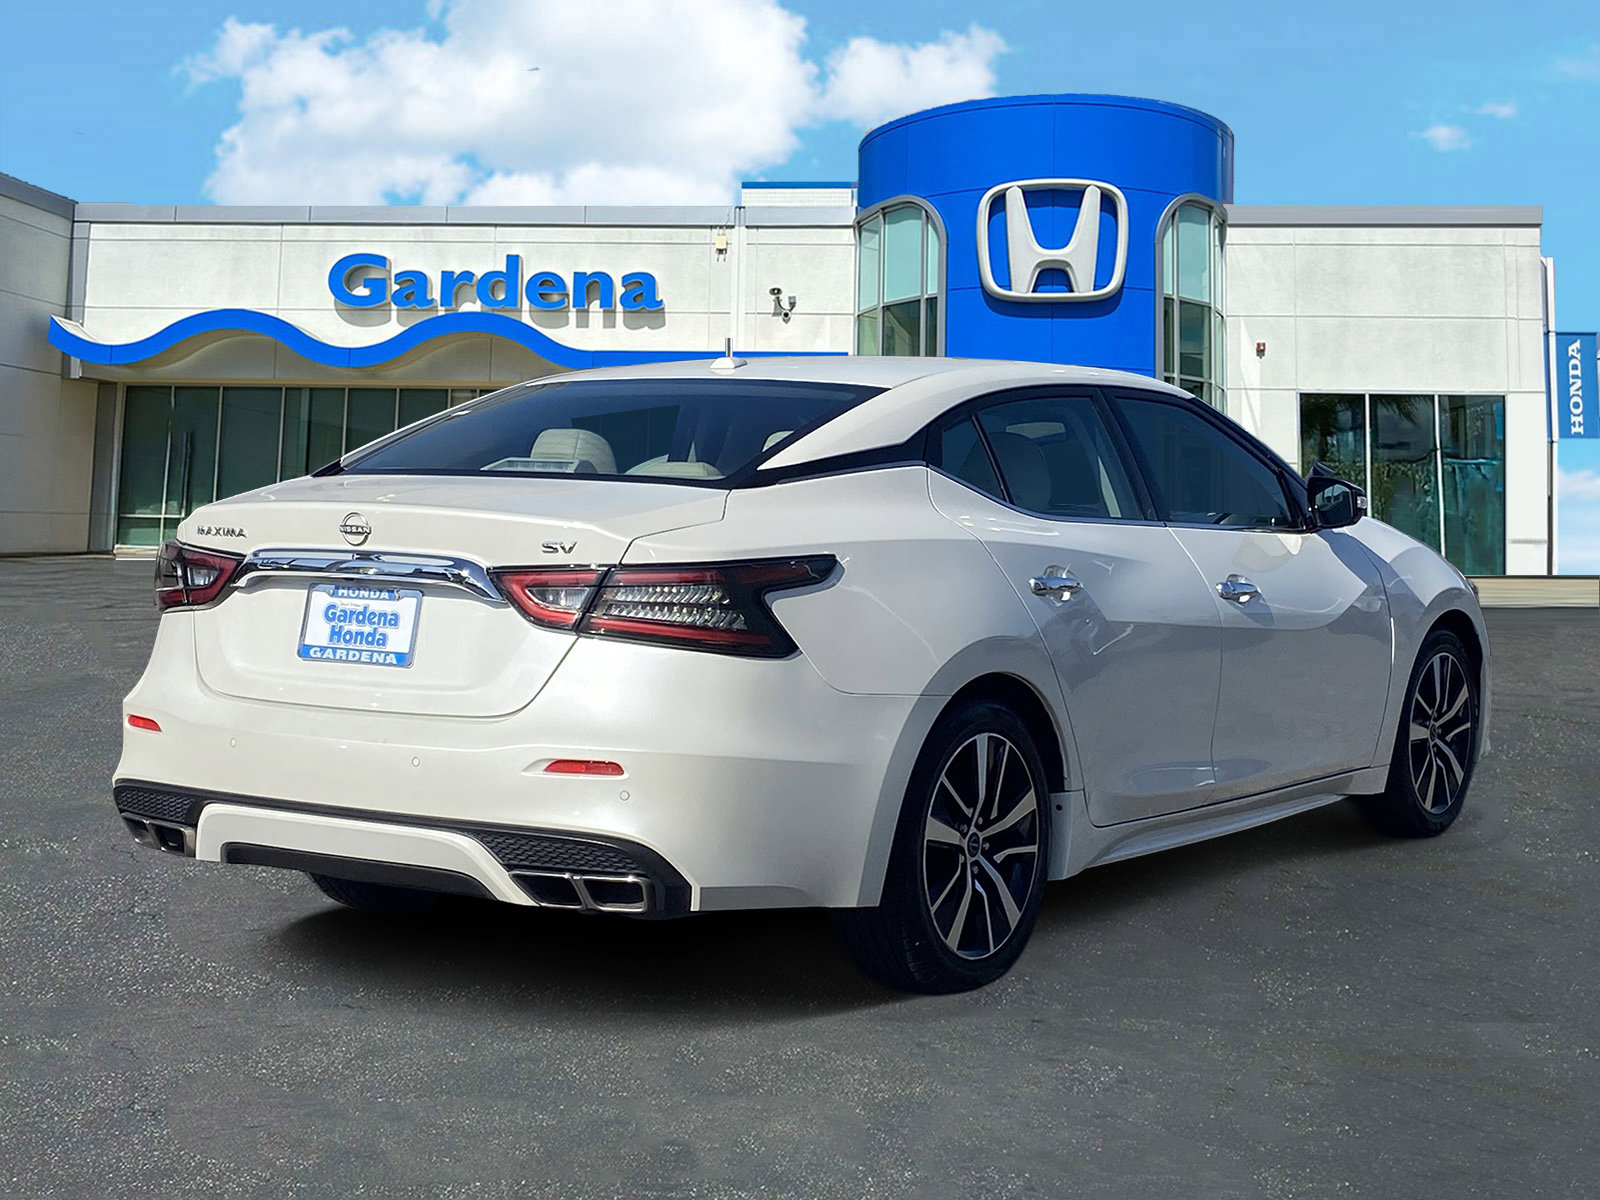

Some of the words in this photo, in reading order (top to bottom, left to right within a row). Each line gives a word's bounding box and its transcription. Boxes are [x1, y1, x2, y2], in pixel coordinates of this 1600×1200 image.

[328, 253, 664, 311] Gardena
[1568, 339, 1584, 435] HONDA
[197, 525, 247, 538] MAXIMA
[339, 524, 371, 535] NISSAN
[541, 540, 577, 554] SV
[337, 588, 390, 600] HONDA
[323, 602, 400, 628] Gardena
[328, 625, 388, 647] Honda
[309, 647, 398, 665] GARDENA
